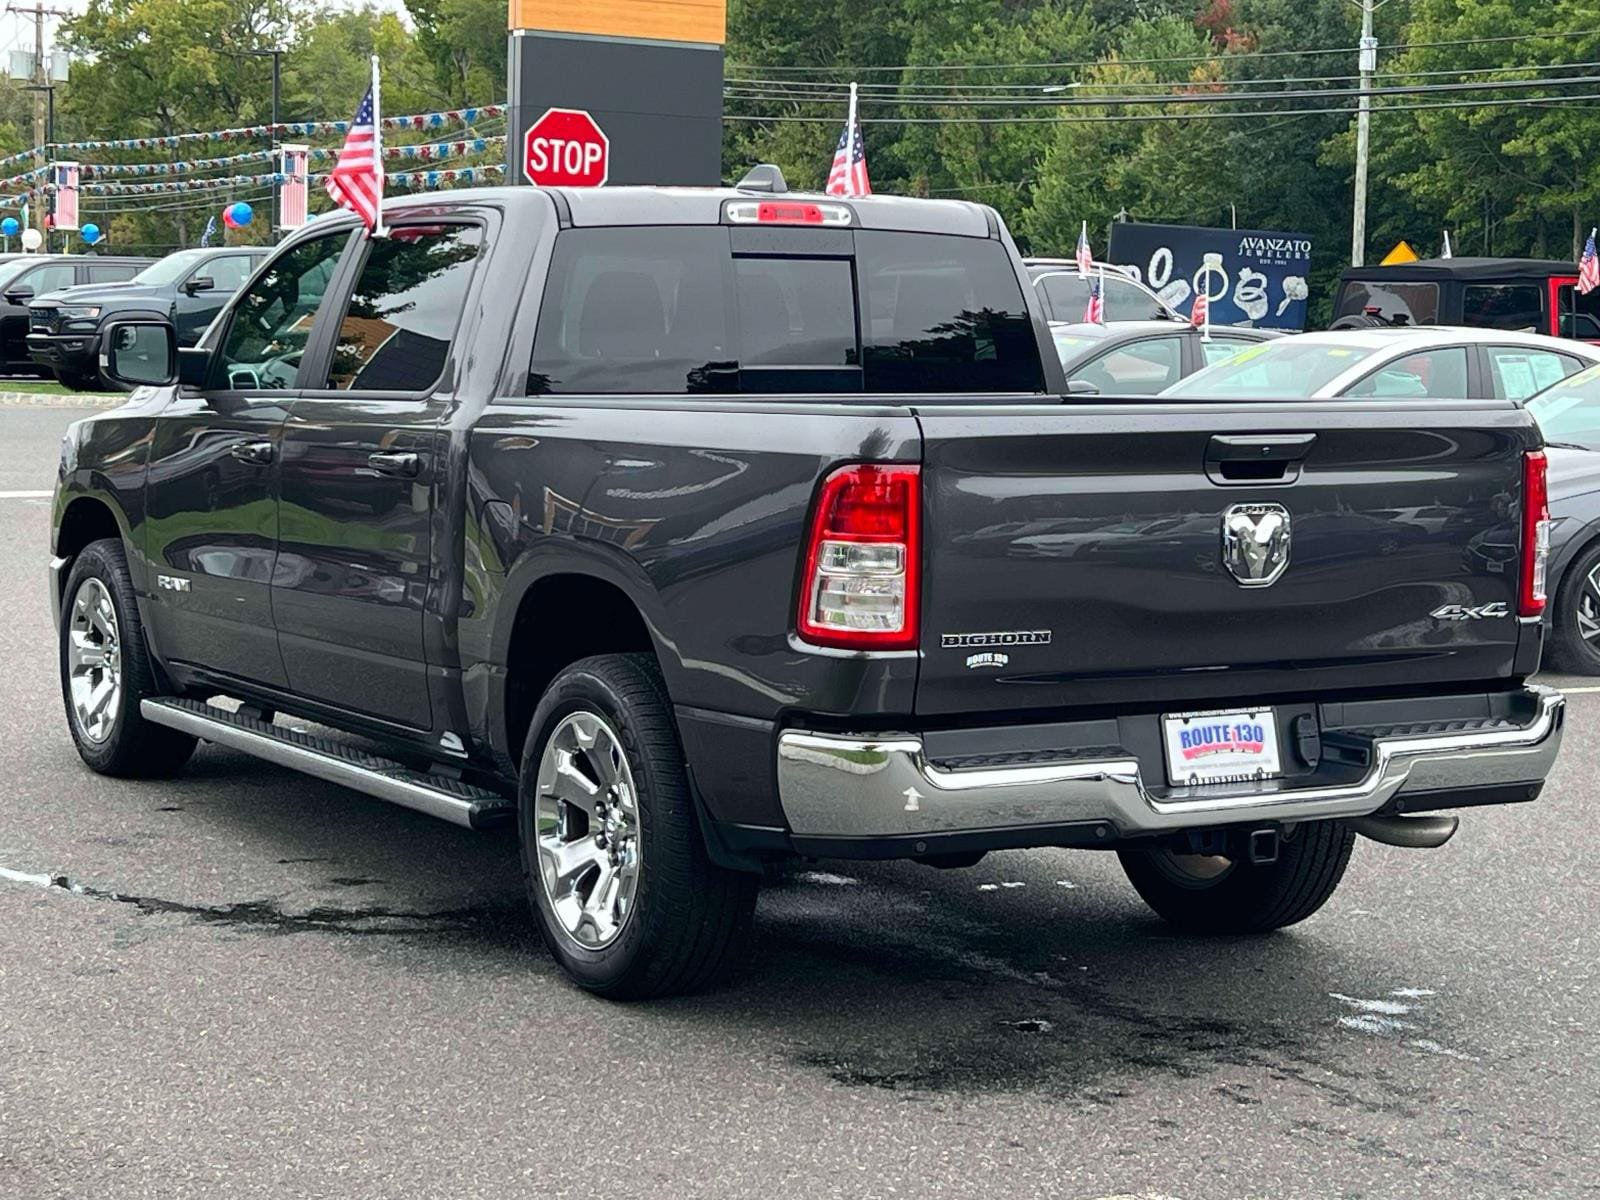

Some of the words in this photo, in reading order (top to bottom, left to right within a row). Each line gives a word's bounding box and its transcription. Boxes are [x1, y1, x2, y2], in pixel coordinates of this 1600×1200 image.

[530, 137, 602, 176] STOP
[1239, 237, 1312, 252] AVANZATO
[1238, 248, 1310, 260] JEWELERS
[941, 630, 1052, 648] BIGHORN
[966, 652, 993, 667] ROUTE
[1180, 724, 1231, 749] ROUTE
[1233, 724, 1264, 742] 130
